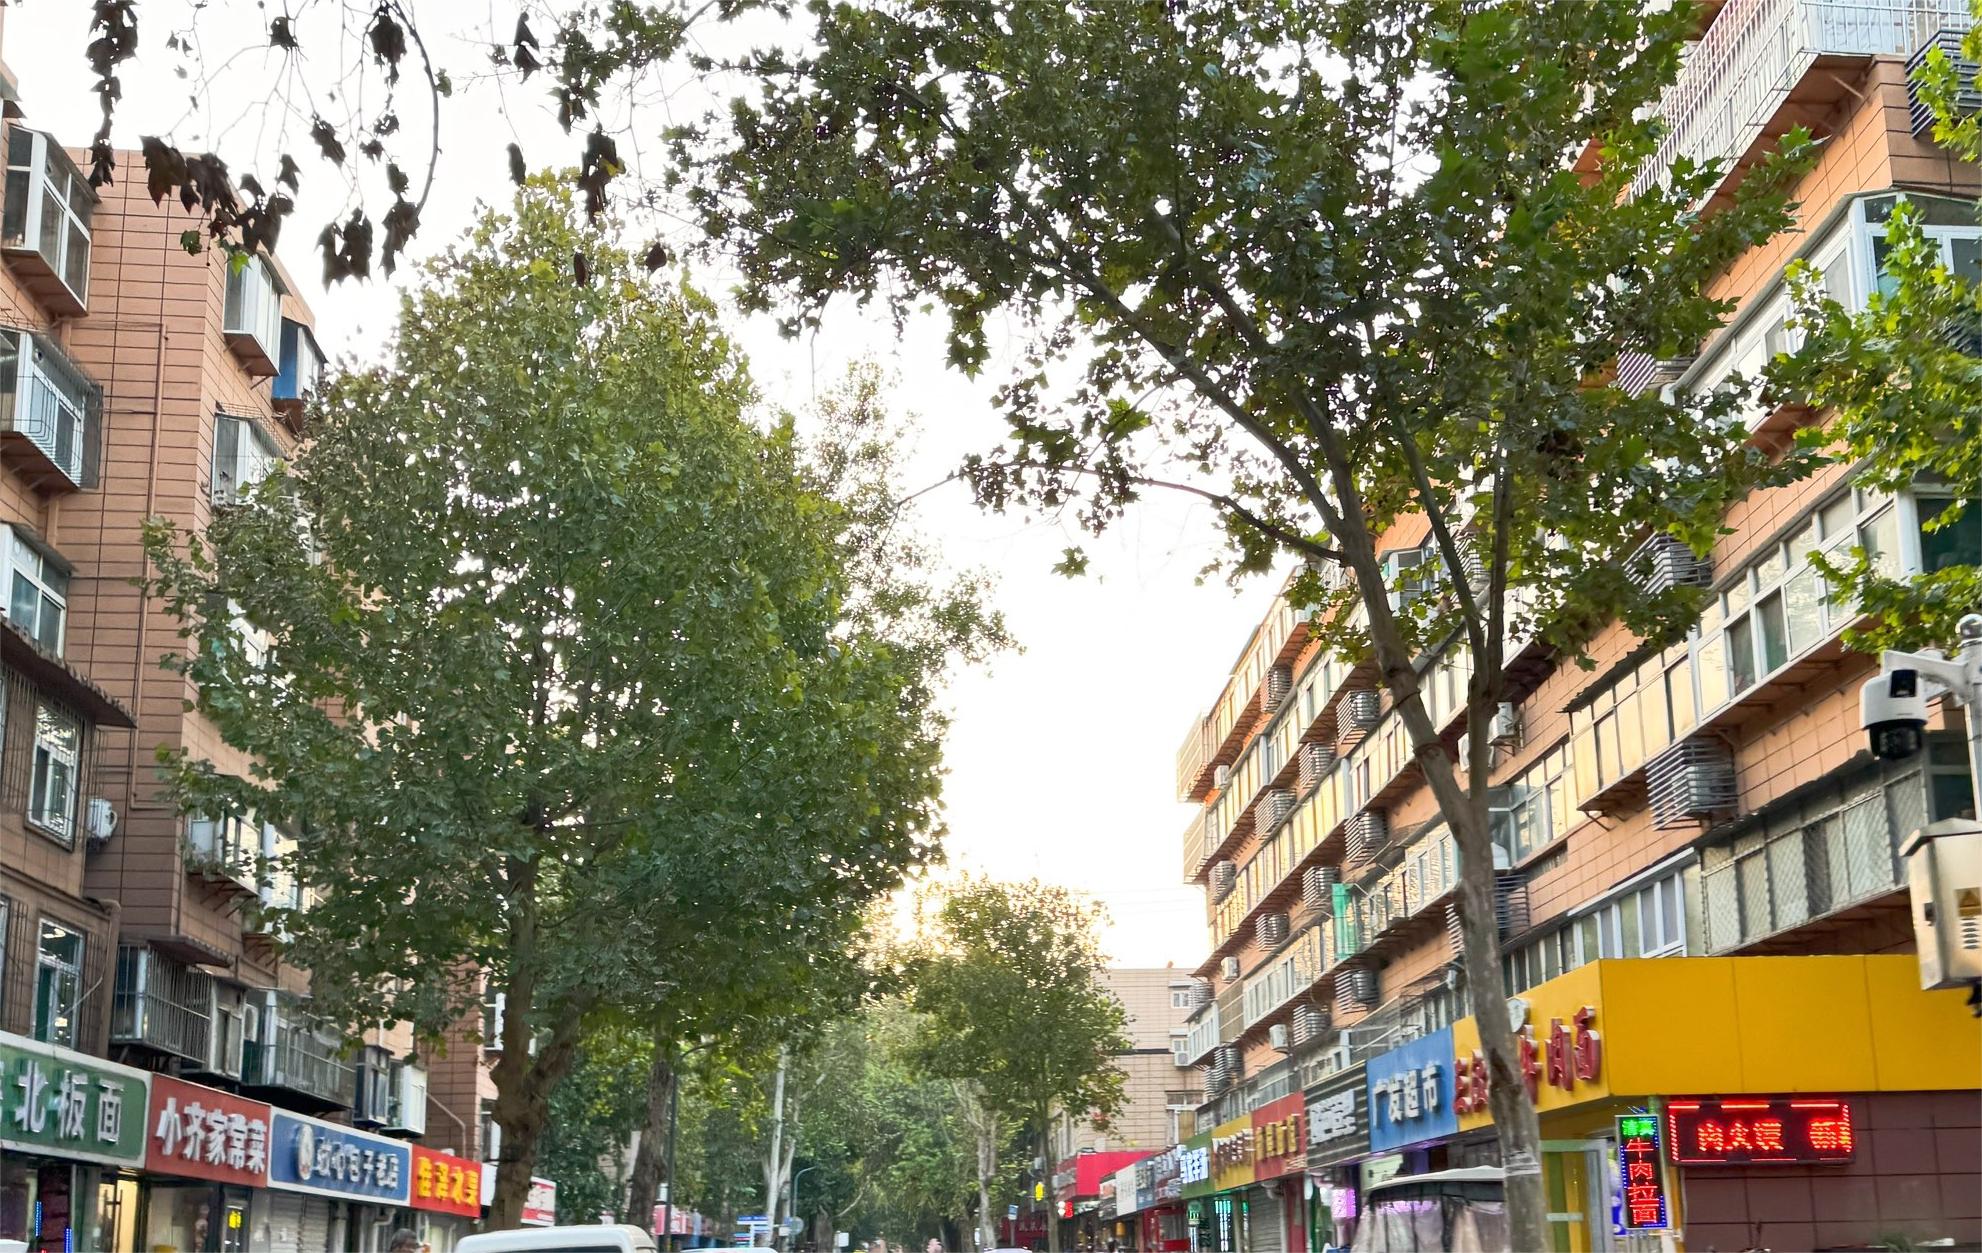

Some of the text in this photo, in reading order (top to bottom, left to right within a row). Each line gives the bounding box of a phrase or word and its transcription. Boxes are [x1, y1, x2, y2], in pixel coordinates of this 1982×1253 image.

[0, 1059, 124, 1145] 北板面
[1372, 1061, 1442, 1129] 广发超市
[156, 1097, 267, 1174] 小齐家常菜
